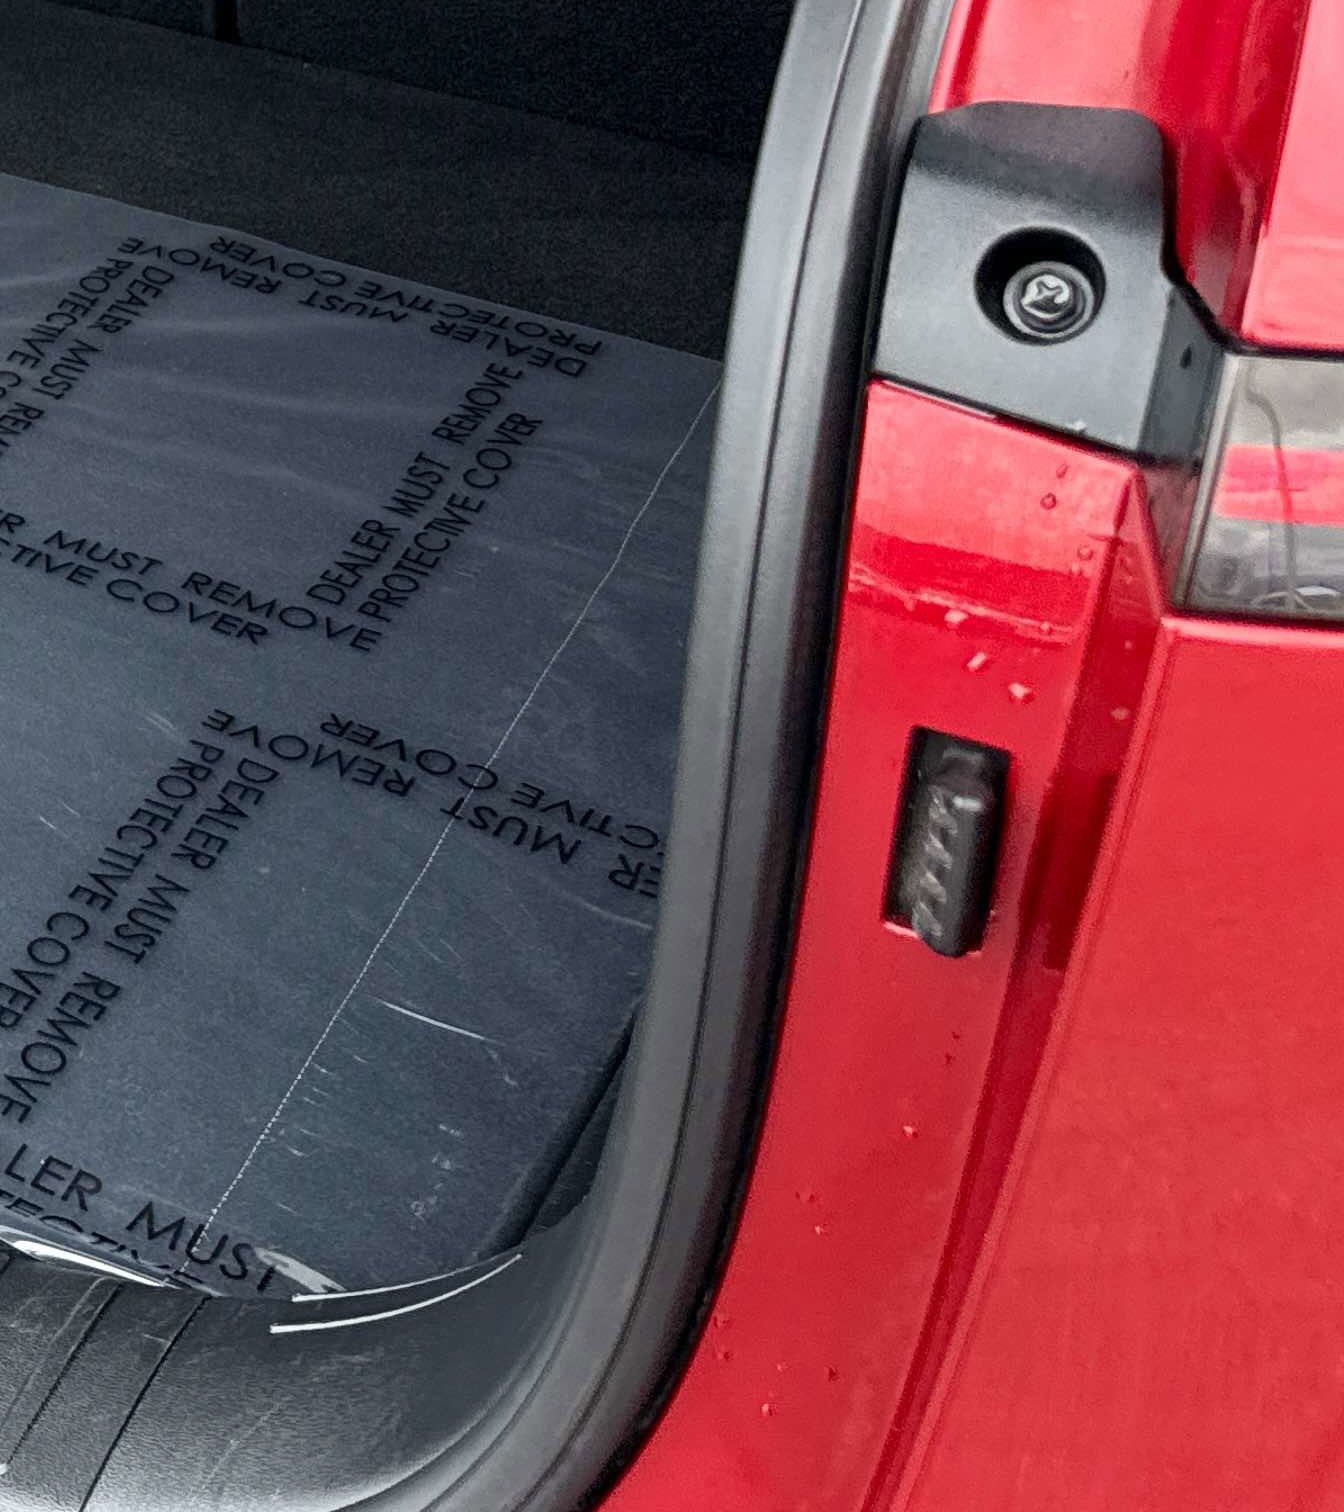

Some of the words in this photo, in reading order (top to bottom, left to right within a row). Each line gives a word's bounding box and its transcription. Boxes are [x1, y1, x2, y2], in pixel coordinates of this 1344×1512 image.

[88, 265, 176, 336] DEALER
[117, 236, 283, 296] REMOVE
[210, 236, 347, 289] COVER
[7, 257, 134, 370] PROTECTIVE
[298, 288, 409, 323] MUST
[354, 280, 604, 356] PROTECTIVE
[32, 339, 104, 400] MUST
[429, 319, 589, 378] DEALER
[305, 519, 401, 606] DEALER
[382, 451, 451, 519] MUST
[431, 362, 523, 446] REMOVE
[357, 493, 485, 623] PROTECTIVE
[462, 412, 544, 489] COVER
[42, 530, 164, 576] MUST
[180, 572, 383, 652] REMOVE
[105, 578, 270, 646] COVER
[201, 708, 416, 797] REMOVE
[319, 712, 499, 791] COVER
[68, 739, 225, 912] PROTECTIVE
[171, 757, 280, 870] DEALER
[440, 796, 583, 865] MUST
[104, 873, 191, 965] MUST
